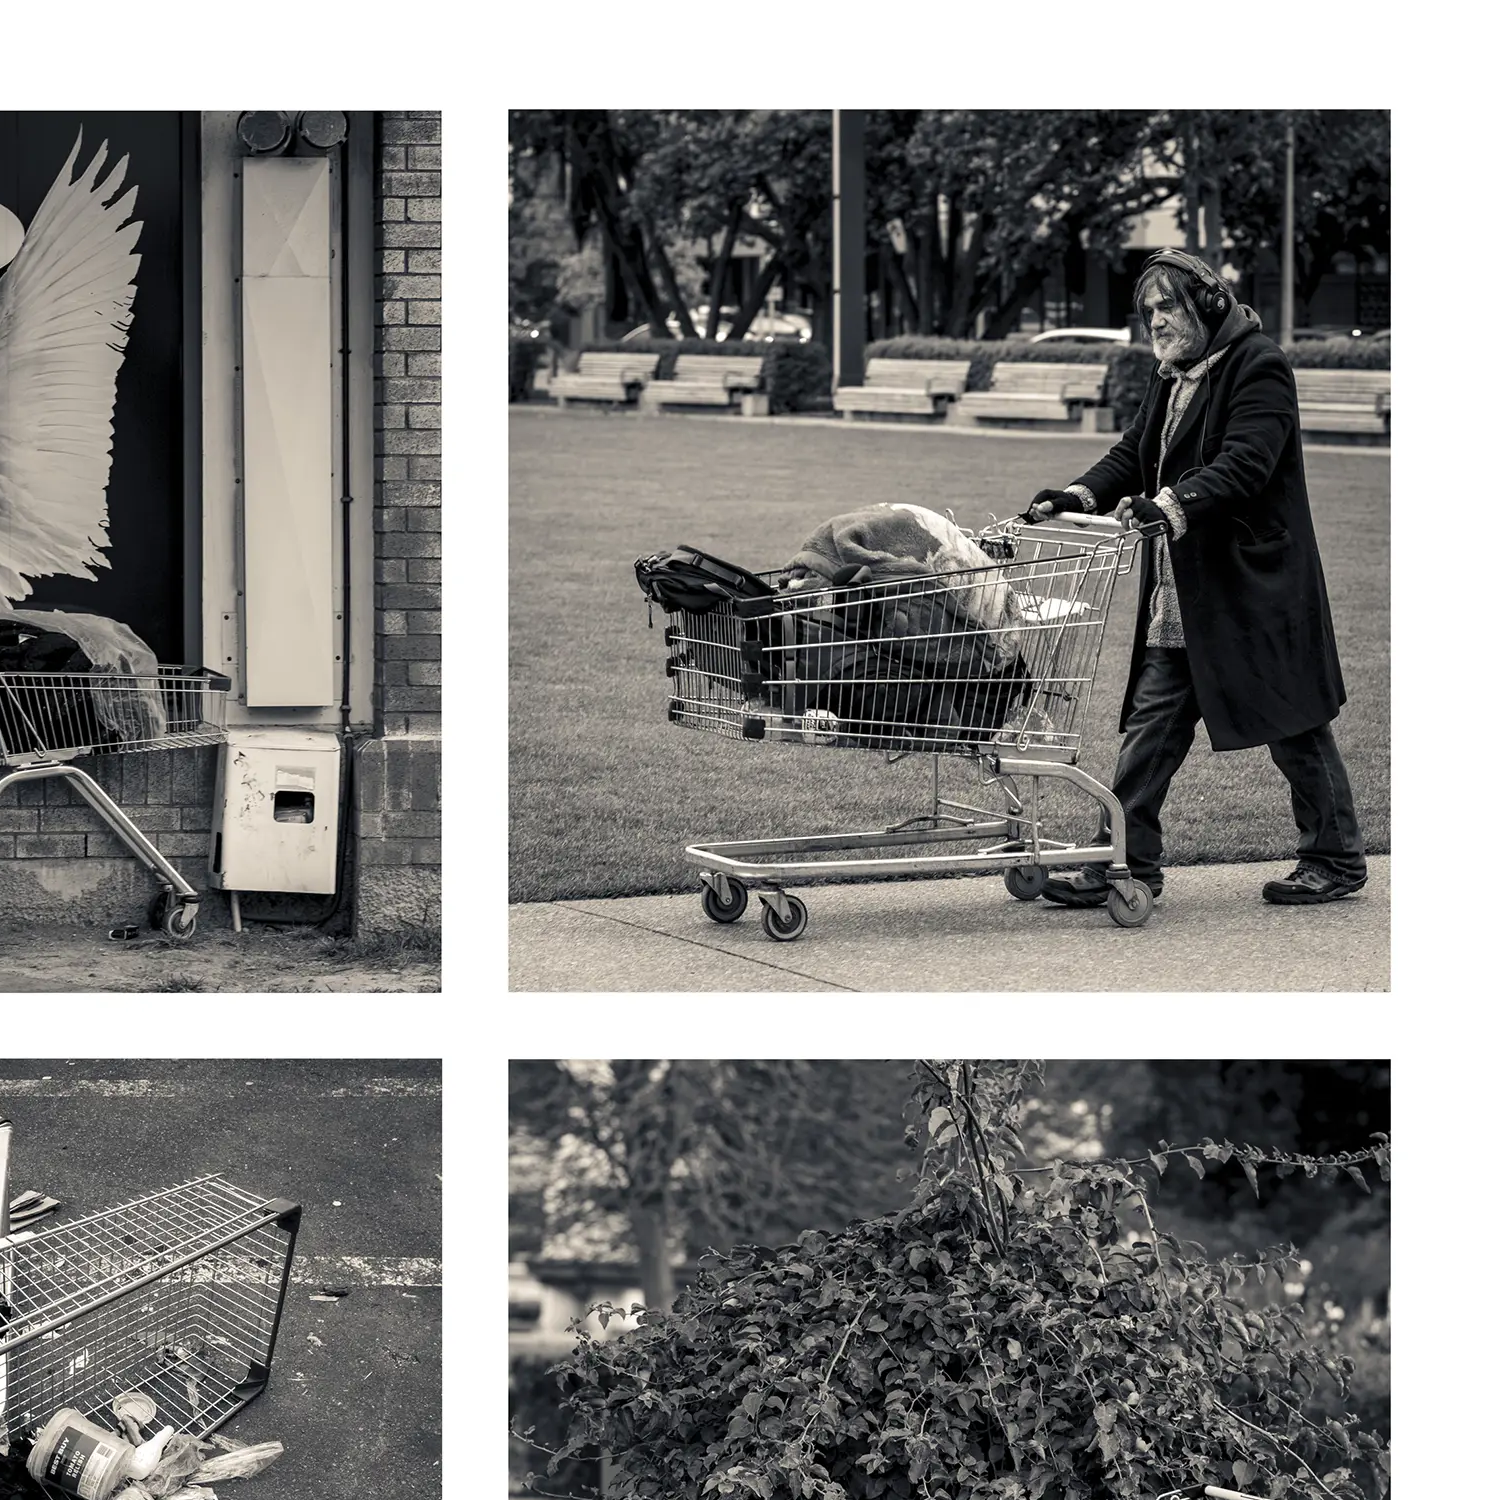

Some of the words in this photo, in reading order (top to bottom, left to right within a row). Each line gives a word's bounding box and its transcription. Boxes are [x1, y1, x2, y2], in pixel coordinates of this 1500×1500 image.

[50, 1454, 61, 1475] BEST
[59, 1437, 70, 1456] BUY
[66, 1450, 81, 1477] TOMATO
[71, 1454, 86, 1479] RELISH
